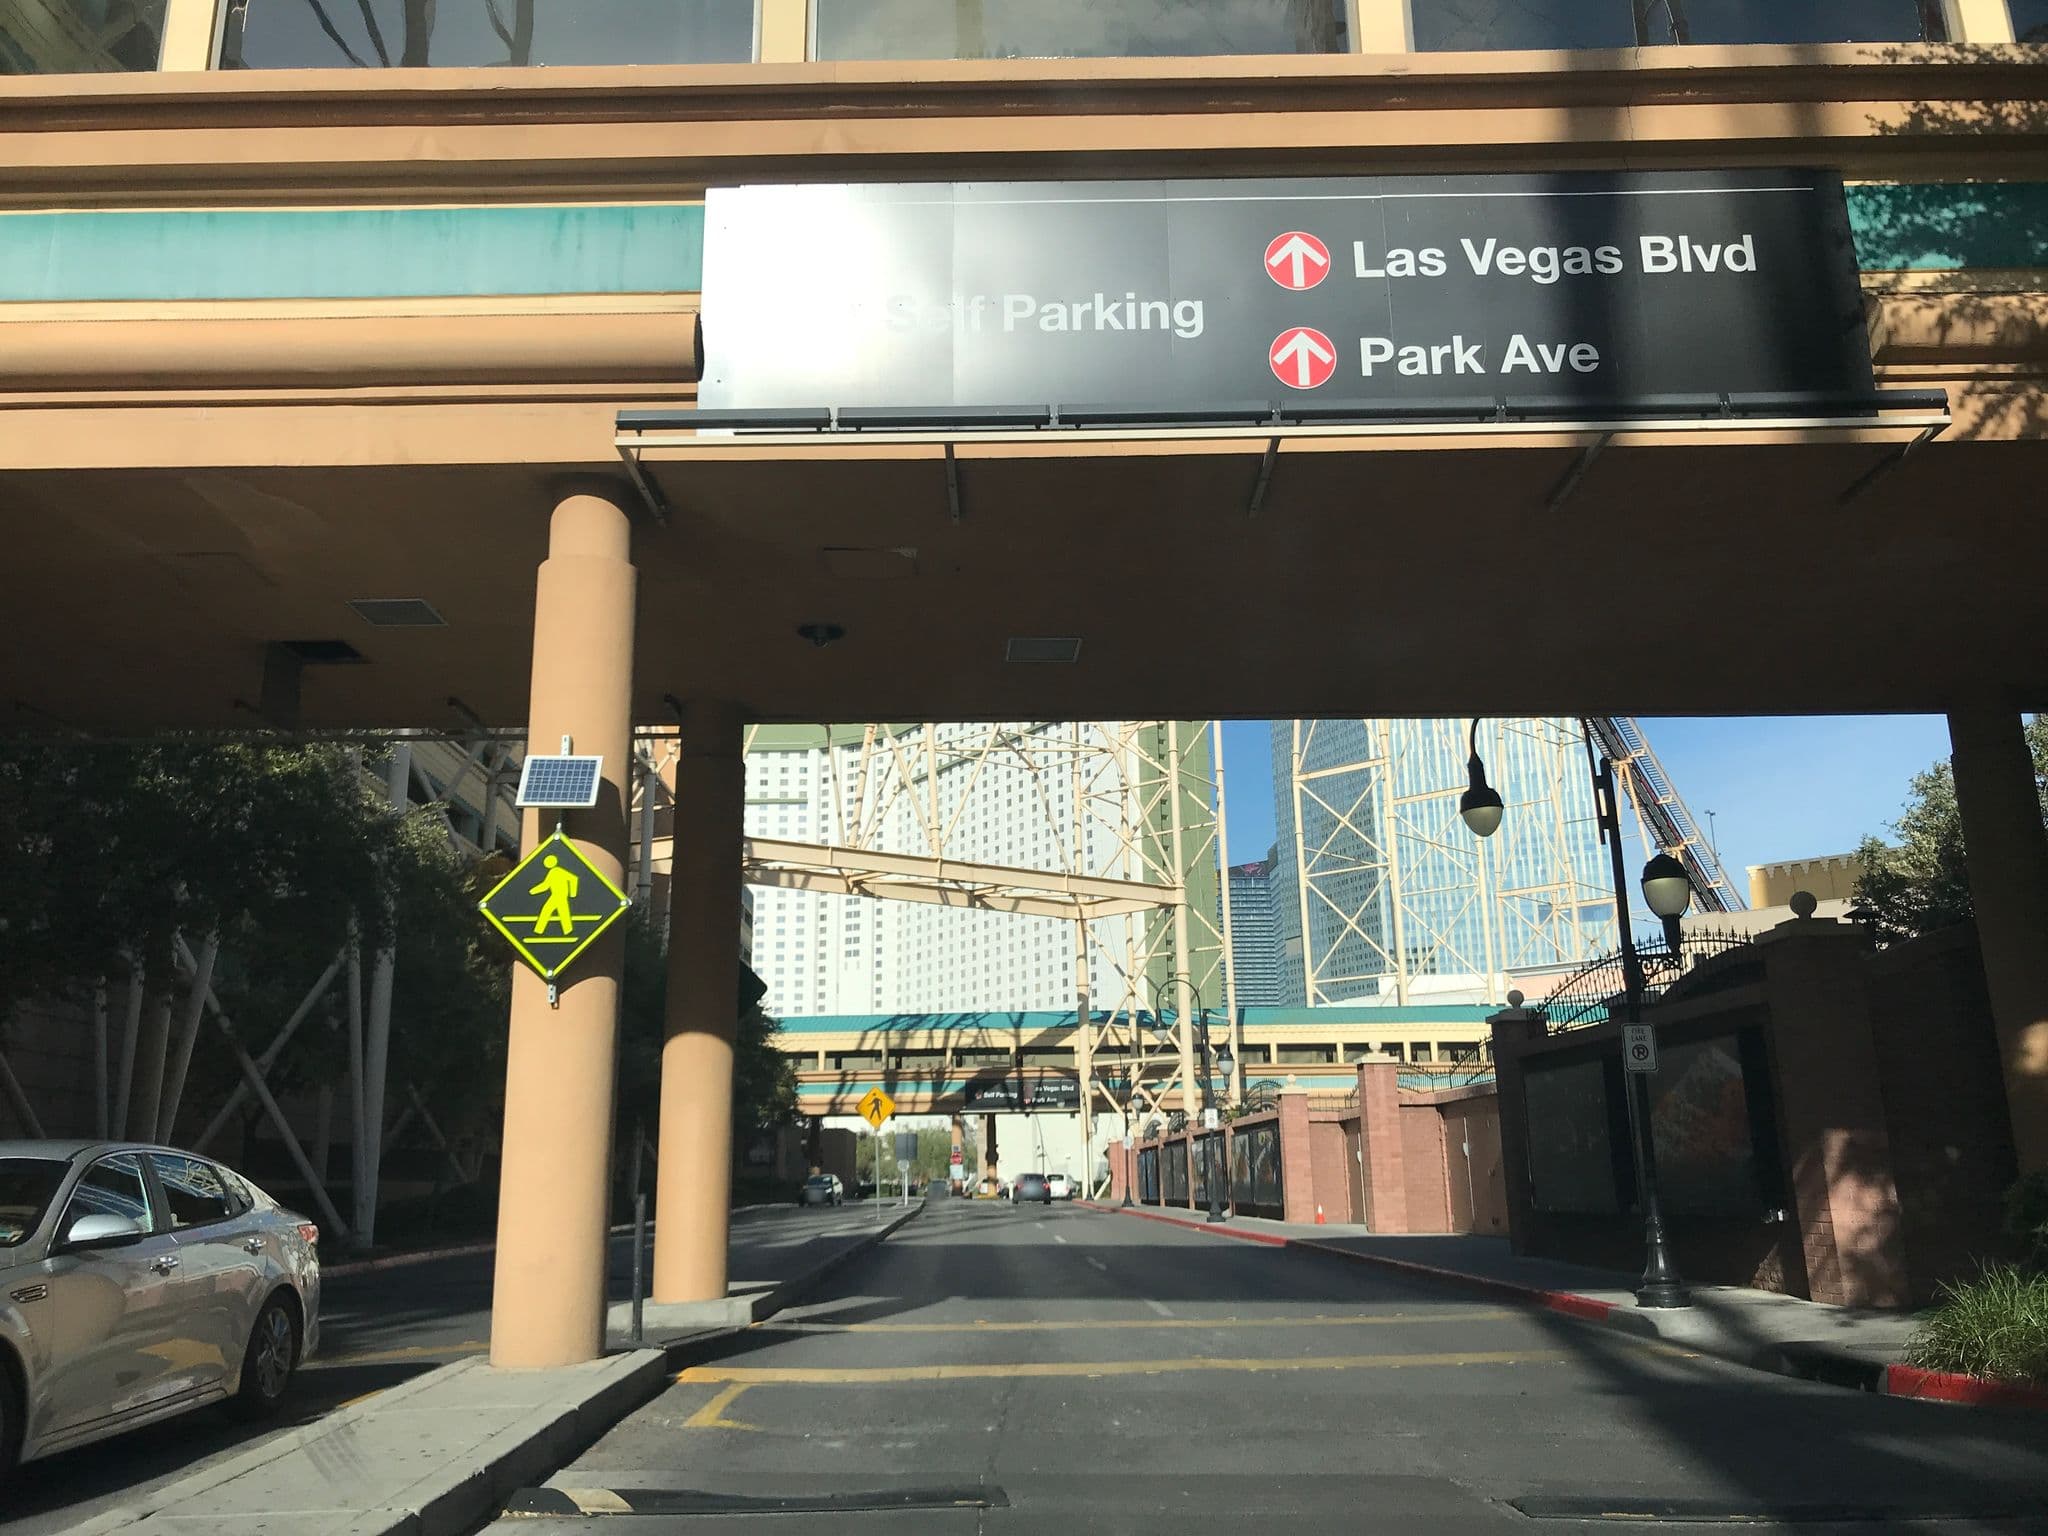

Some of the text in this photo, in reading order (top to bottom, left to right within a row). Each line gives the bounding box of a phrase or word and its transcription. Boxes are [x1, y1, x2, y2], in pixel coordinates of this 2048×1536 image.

[1353, 234, 1758, 284] Las Vegas Blvd
[885, 292, 1204, 340] Self Parking
[1359, 334, 1600, 377] Park Ave
